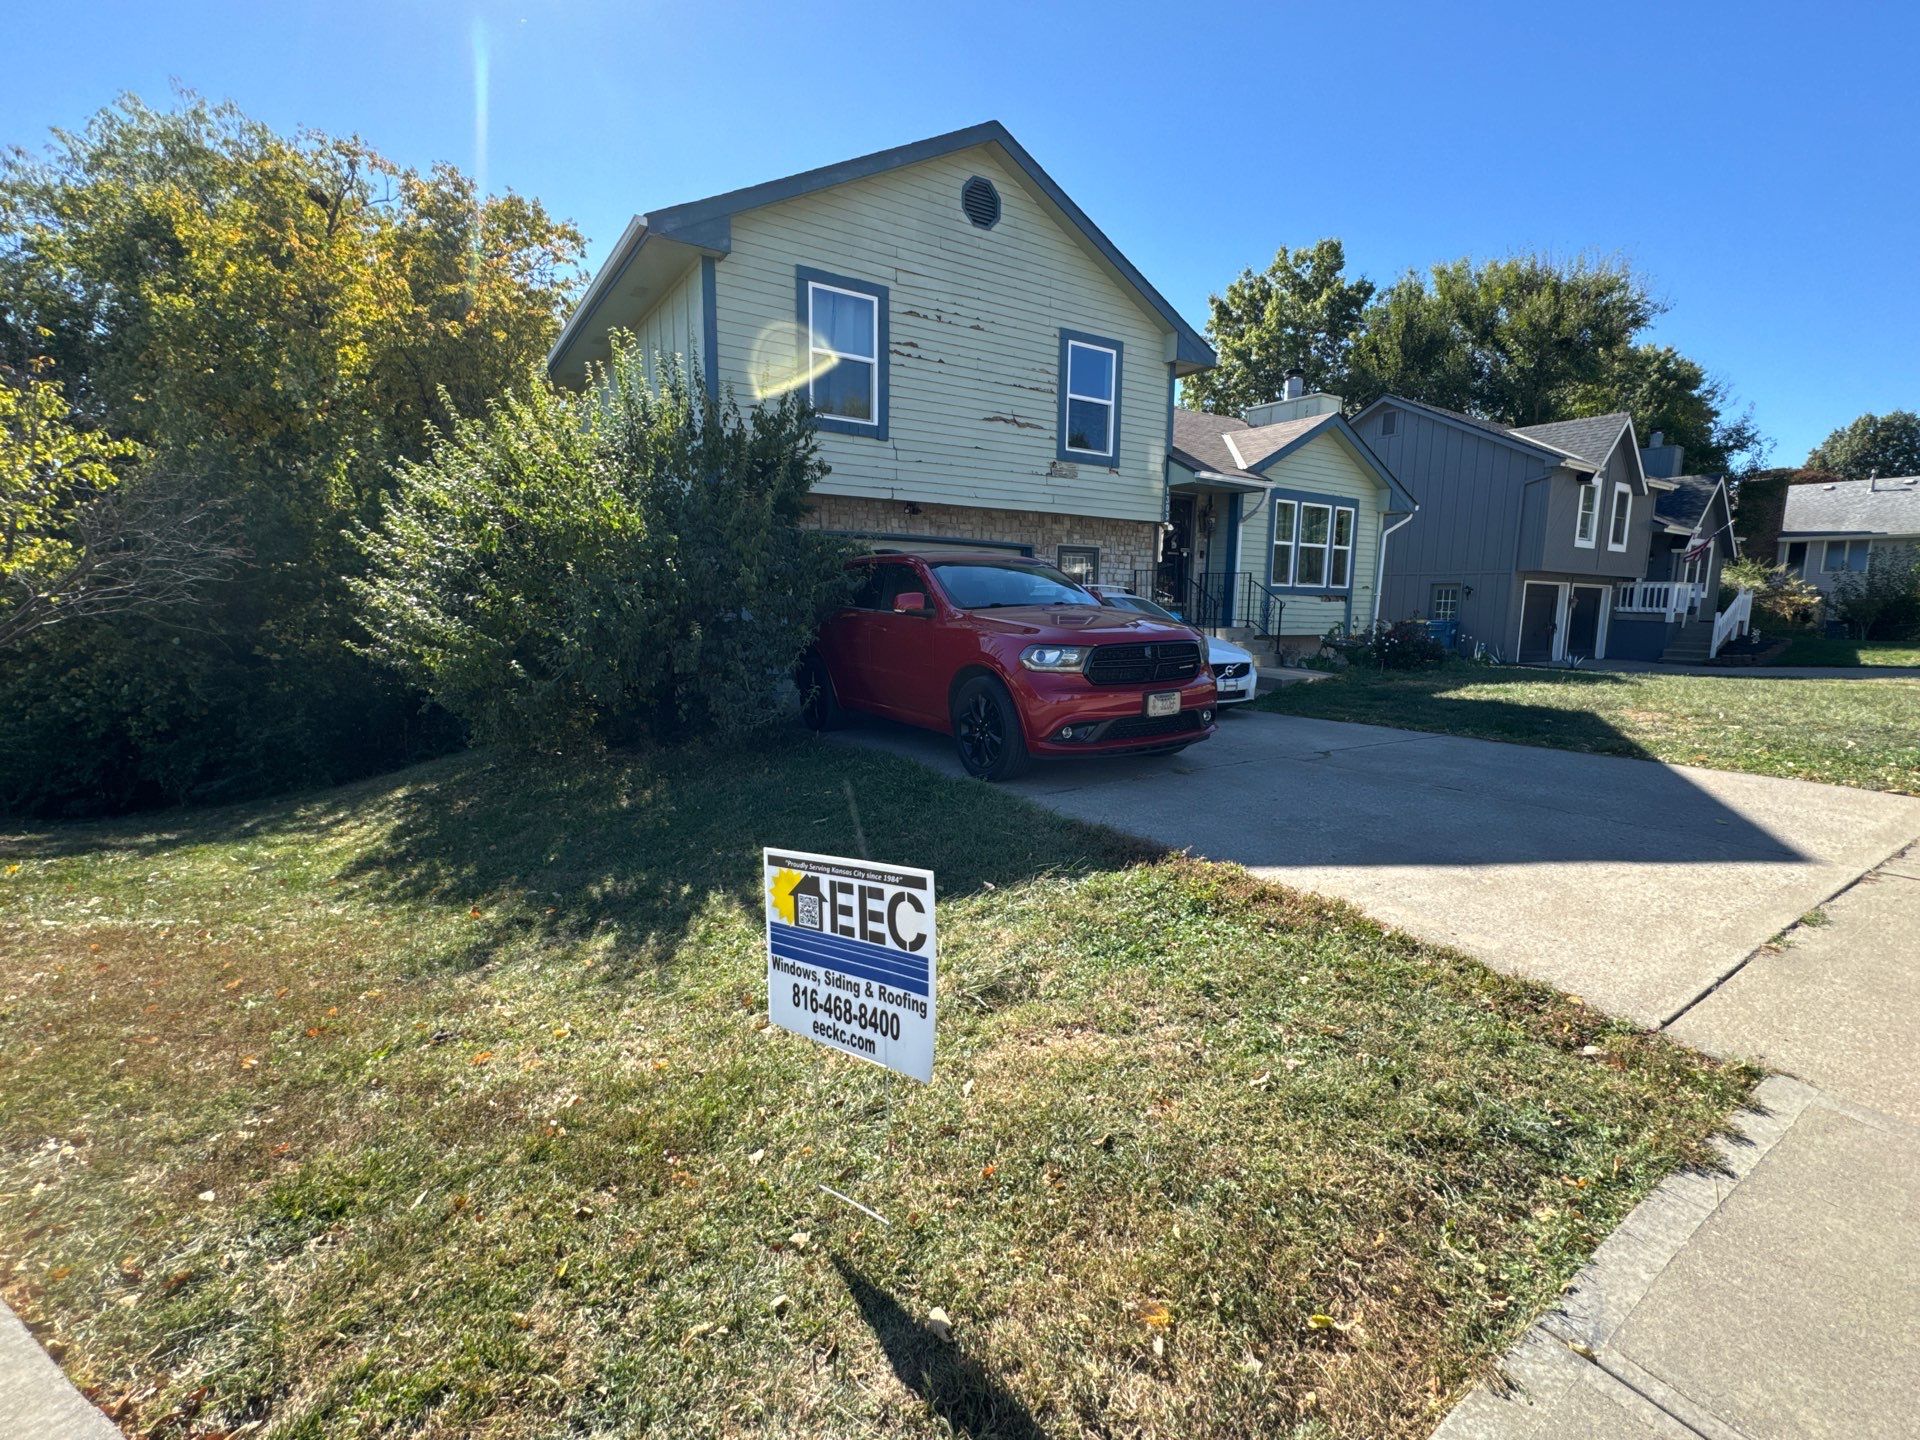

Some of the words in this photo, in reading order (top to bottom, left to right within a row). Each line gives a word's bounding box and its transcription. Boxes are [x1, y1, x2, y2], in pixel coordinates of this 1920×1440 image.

[785, 859, 808, 870] "Proudly
[809, 863, 831, 874] Serving
[831, 866, 852, 876] Kansas
[853, 869, 866, 879] City
[866, 872, 882, 881] since
[883, 874, 903, 883] 1984"
[829, 880, 927, 952] EEC
[771, 955, 821, 987] Windows,
[824, 971, 861, 998] Siding
[865, 982, 875, 998] &
[879, 987, 928, 1019] Roofing
[792, 983, 901, 1041] 816-468-8400
[812, 1019, 876, 1055] eeckc.com
